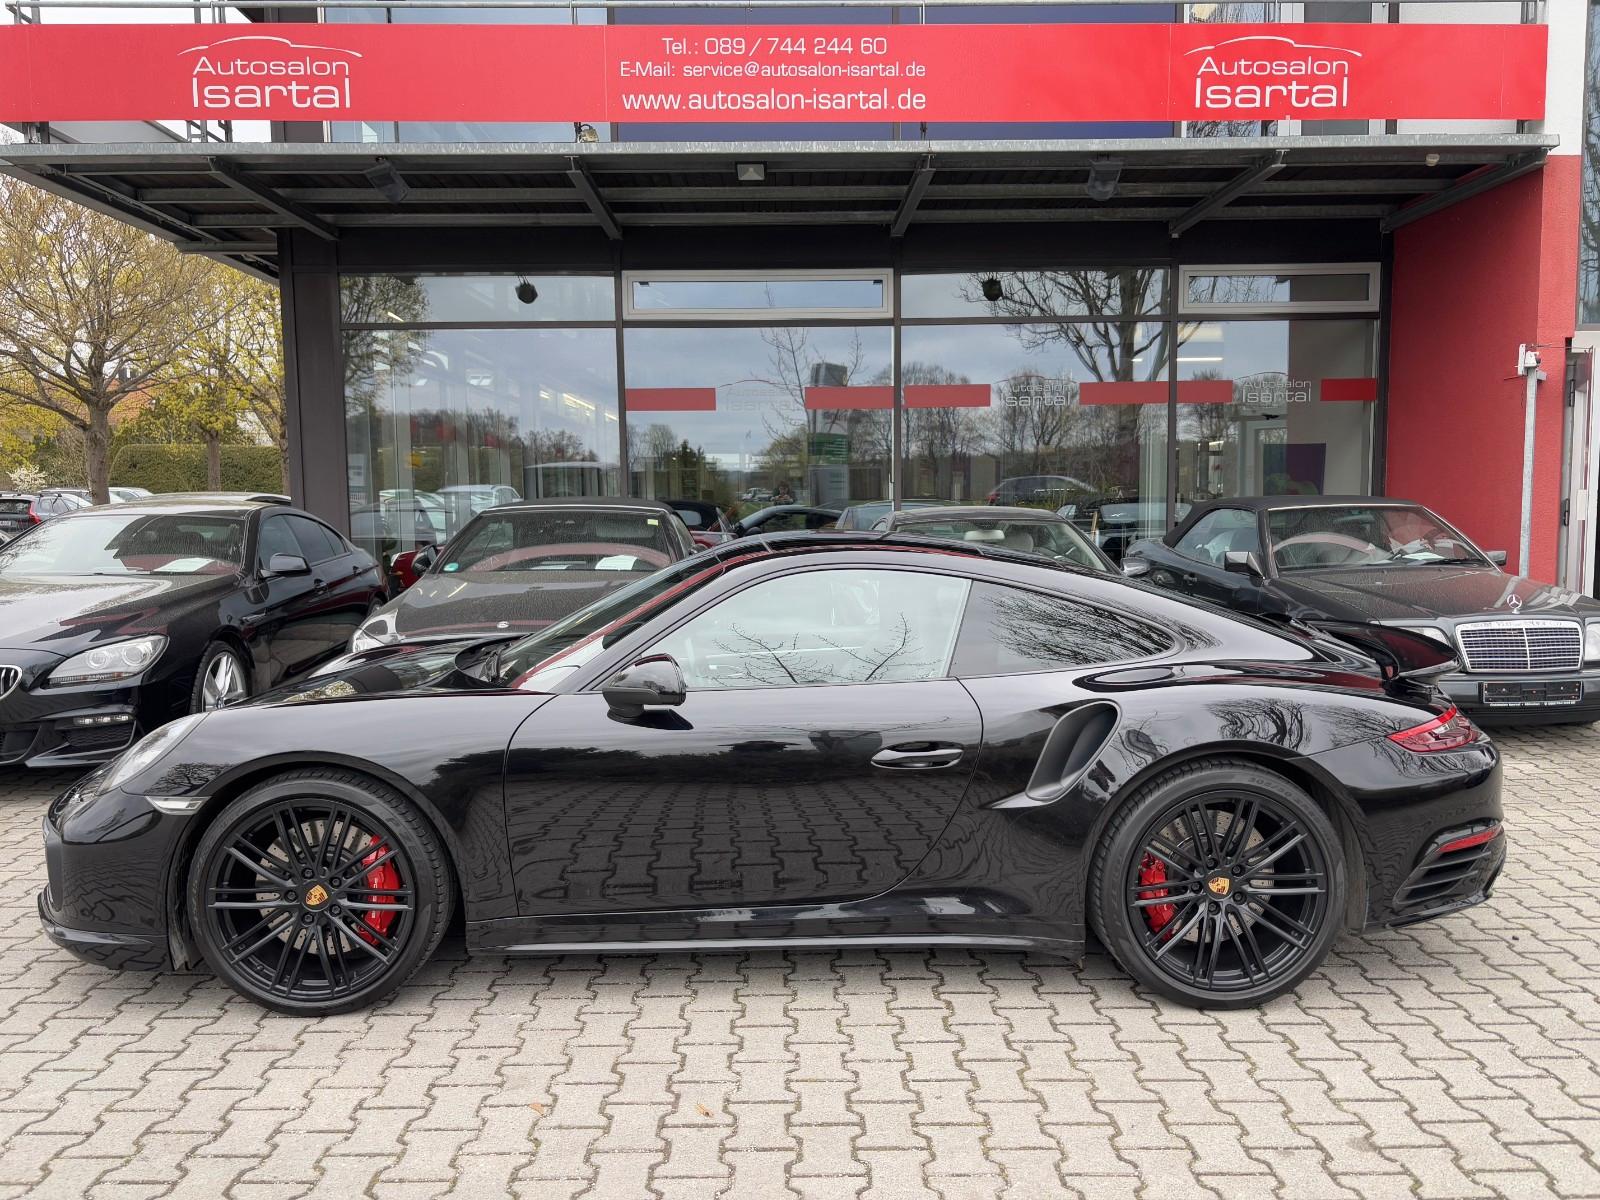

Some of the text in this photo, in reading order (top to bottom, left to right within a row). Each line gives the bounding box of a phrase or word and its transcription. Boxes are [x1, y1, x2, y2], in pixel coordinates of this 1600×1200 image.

[661, 37, 699, 55] Tel.:
[813, 37, 854, 55] 244
[860, 37, 888, 55] 60
[192, 56, 350, 76] Autosalon
[619, 61, 926, 78] E-Mail: service@autosalon-isartal.de
[1196, 55, 1349, 76] Autosalon
[191, 77, 351, 109] Isartal
[621, 87, 927, 111] www.autosalon-isartal.de
[1194, 76, 1349, 109] Isartal
[1242, 378, 1312, 389] Autosalon
[1000, 391, 1072, 407] Isartal
[1242, 387, 1312, 403] Isartal
